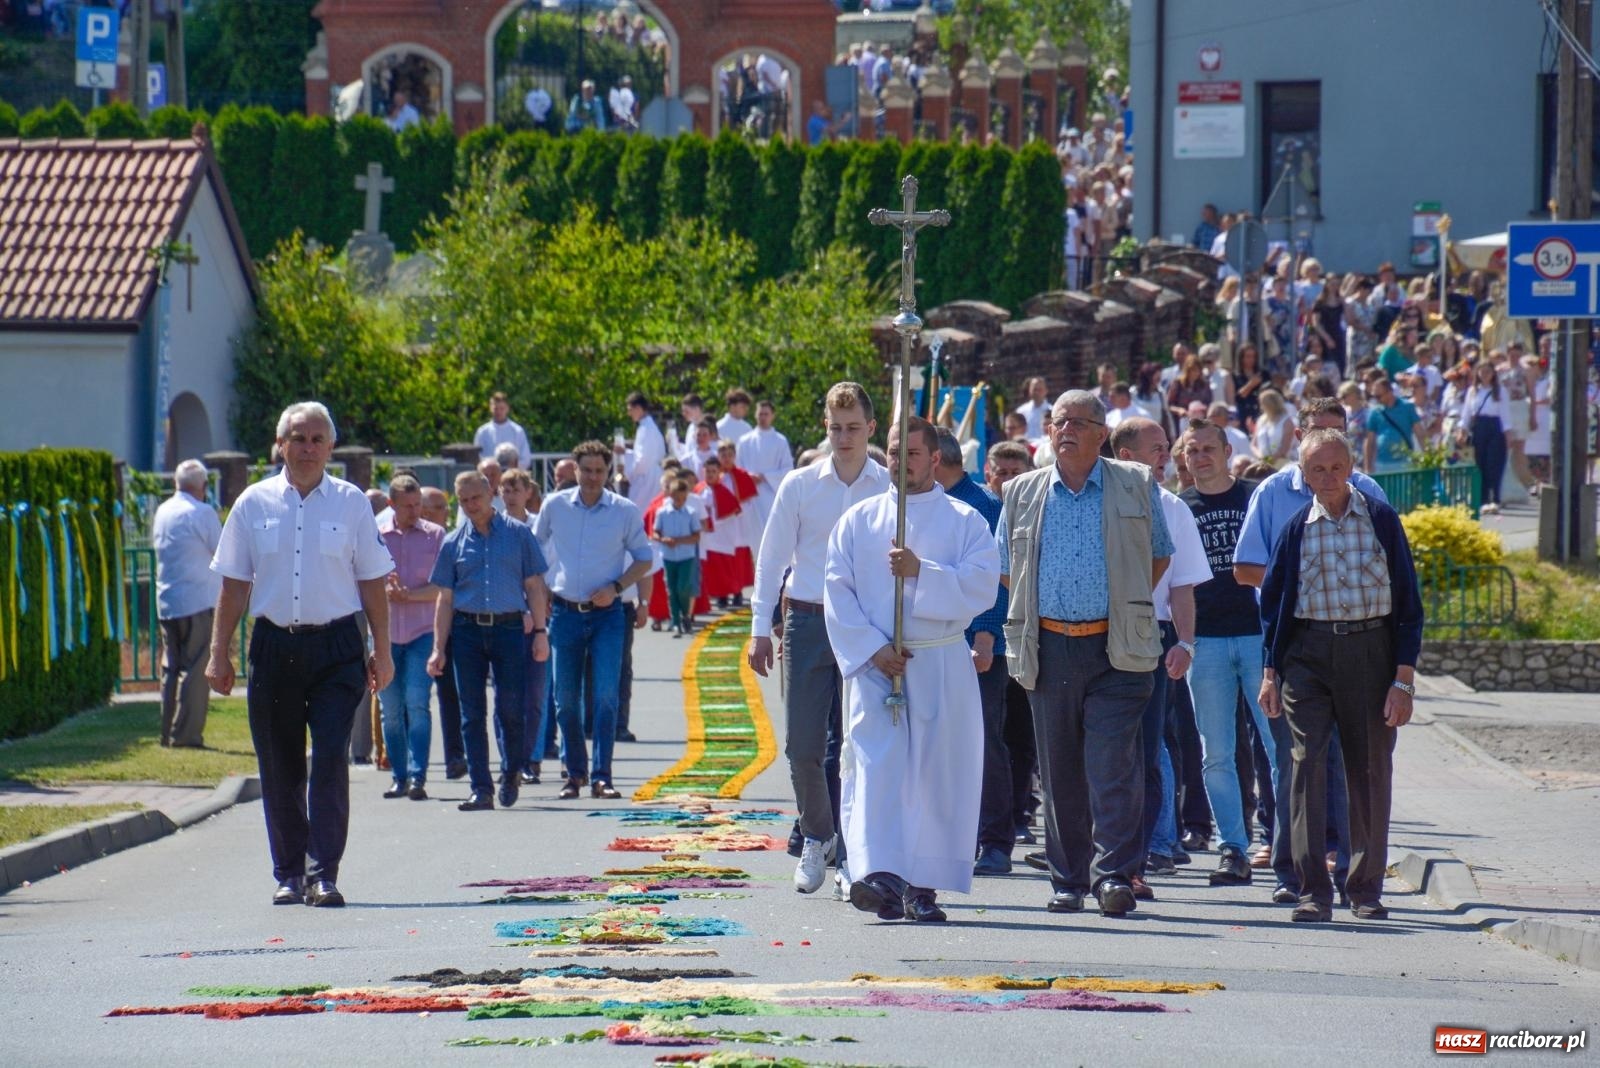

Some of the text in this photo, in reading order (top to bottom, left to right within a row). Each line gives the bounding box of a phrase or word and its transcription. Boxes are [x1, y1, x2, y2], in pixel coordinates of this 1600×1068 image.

[86, 13, 110, 46] P
[147, 70, 161, 104] P
[1195, 510, 1246, 525] AUTHENTIC
